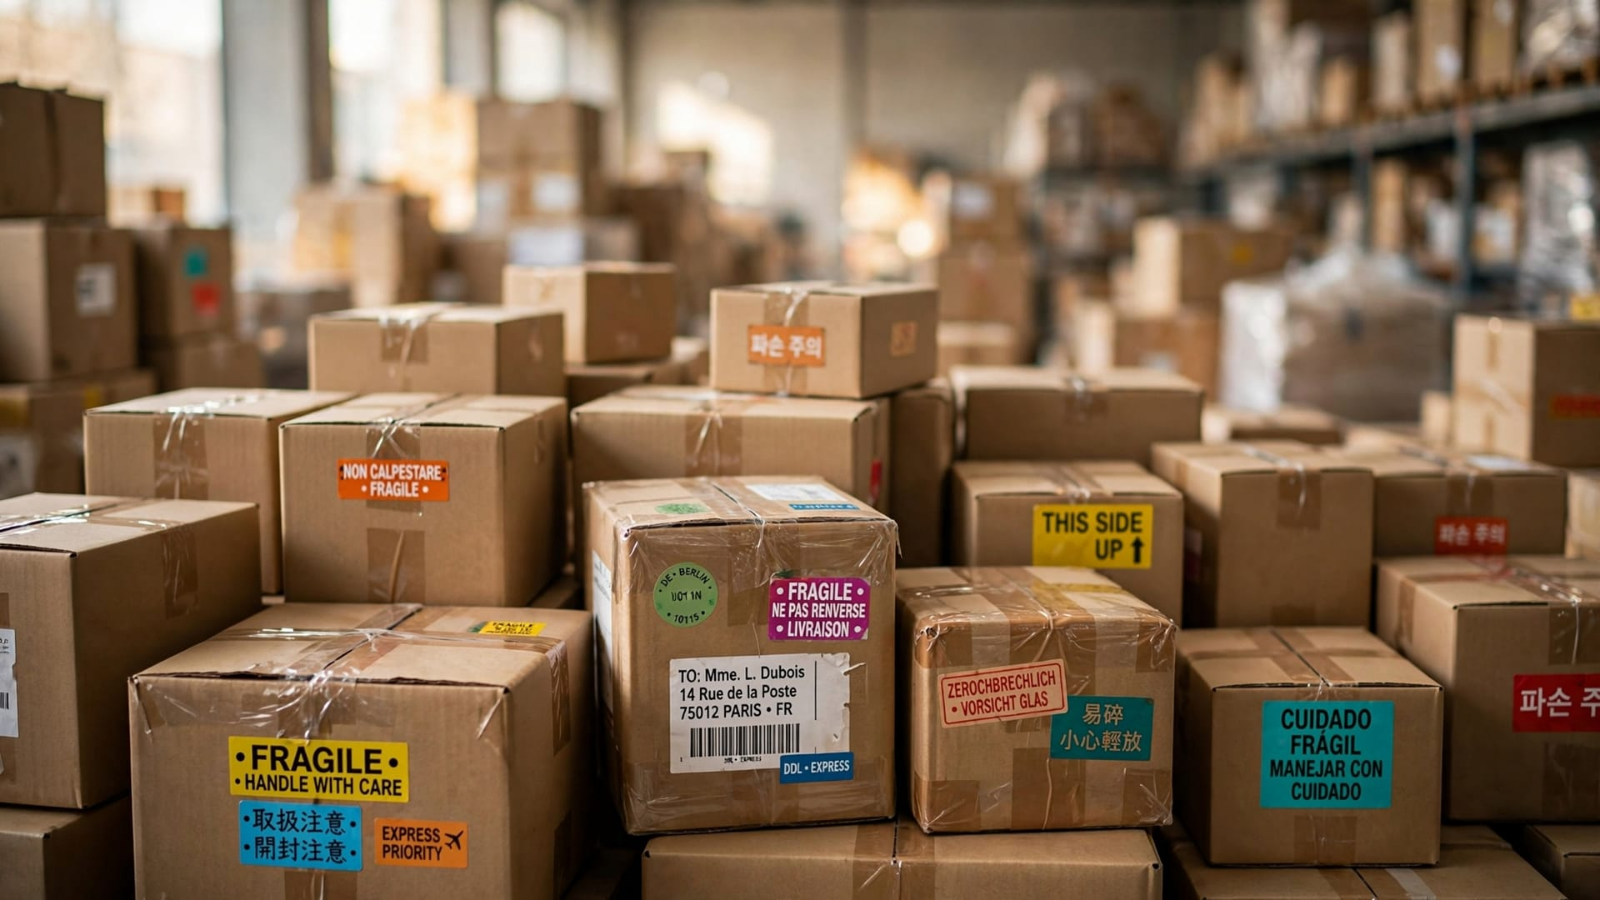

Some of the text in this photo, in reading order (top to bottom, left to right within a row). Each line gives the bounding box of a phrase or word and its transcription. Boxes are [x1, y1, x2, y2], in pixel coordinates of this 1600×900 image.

[751, 333, 822, 359] 파손 주의
[343, 464, 442, 480] NON CALPESTARE
[370, 482, 419, 497] FRAGILE
[1042, 512, 1143, 533] THIS SIDE
[1440, 523, 1470, 546] 파손
[1095, 538, 1123, 560] UP
[660, 567, 710, 587] DE BERLIN
[788, 582, 853, 601] FRAGILE
[674, 613, 699, 624] 10115
[772, 603, 866, 619] NE PAS RENVERSE
[787, 621, 849, 638] LIVRAISON
[678, 665, 805, 683] TO: Mme. L. Dubois
[680, 684, 797, 702] 14 Rue de la Poste
[947, 670, 1056, 699] ZEROCHBRECHLICH
[680, 702, 793, 720] 75012 PARIS FR
[961, 691, 1048, 716] VORSICHT GLAS
[1520, 687, 1572, 718] 파손
[1082, 703, 1123, 726] 易碎
[1281, 708, 1372, 730] CUIDADO
[1060, 729, 1142, 752] 小心輕放
[1290, 729, 1361, 755] FRÁGIL
[252, 744, 382, 774] FRAGILE
[784, 760, 850, 775] DDL EXPRESS
[1270, 760, 1382, 778] MANEJAR CON
[245, 773, 402, 796] HANDLE WITH CARE
[1291, 782, 1361, 800] CUIDADO
[252, 808, 346, 836] 取扱注意
[382, 826, 440, 843] EXPRESS
[254, 836, 347, 864] 開封注意
[382, 844, 442, 861] PRIORITY
